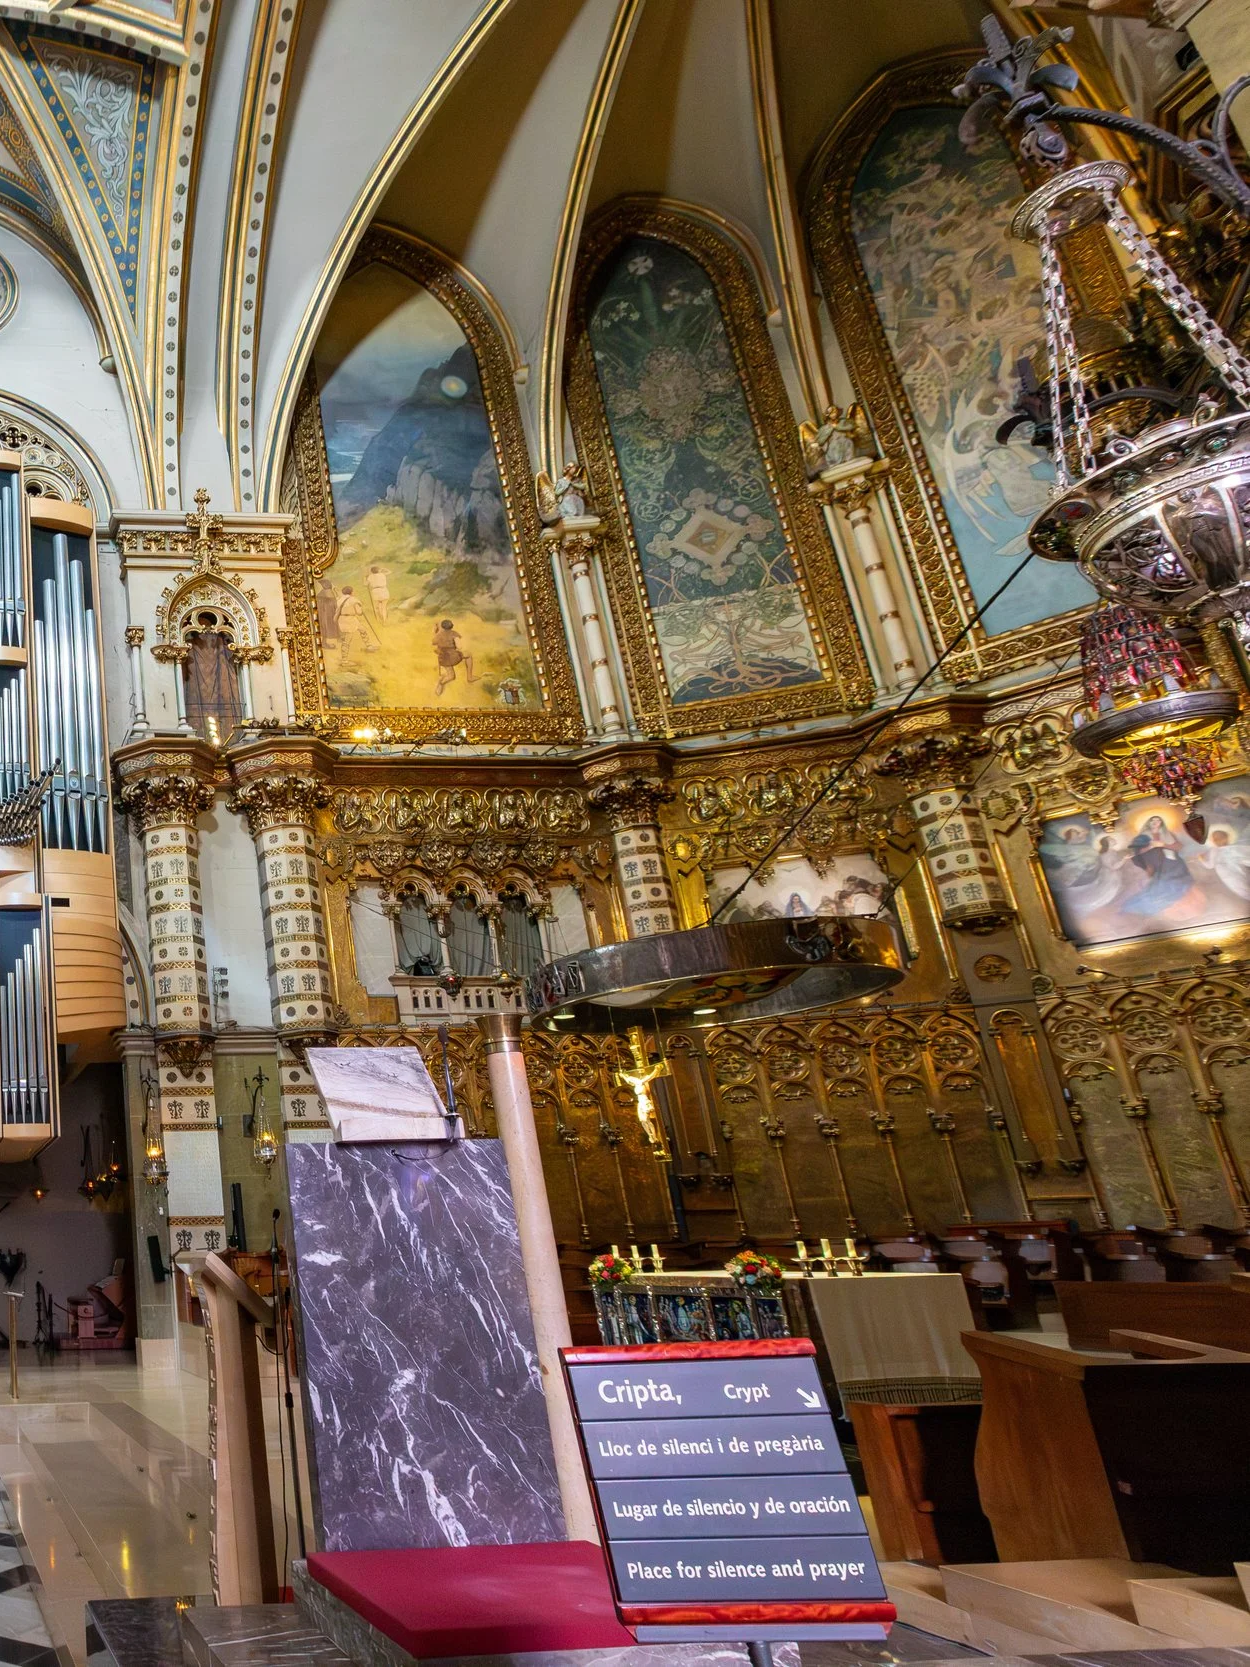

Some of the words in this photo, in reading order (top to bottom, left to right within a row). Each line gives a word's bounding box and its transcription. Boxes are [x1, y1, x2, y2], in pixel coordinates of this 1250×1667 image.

[598, 1378, 682, 1409] Cripta,
[723, 1383, 771, 1403] Crypt
[598, 1440, 633, 1457] Lloc
[637, 1439, 657, 1455] de
[661, 1438, 714, 1455] silenci
[716, 1437, 724, 1453] i
[729, 1436, 750, 1453] de
[754, 1434, 825, 1457] pregària
[613, 1501, 658, 1521] Lugar
[662, 1499, 683, 1517] de
[686, 1498, 746, 1516] silencio
[749, 1501, 760, 1519] y
[764, 1497, 786, 1514] de
[789, 1495, 851, 1514] oración
[627, 1561, 672, 1579] Place
[676, 1560, 702, 1578] for
[707, 1560, 767, 1578] silence
[771, 1559, 804, 1577] and
[808, 1562, 865, 1581] prayer
